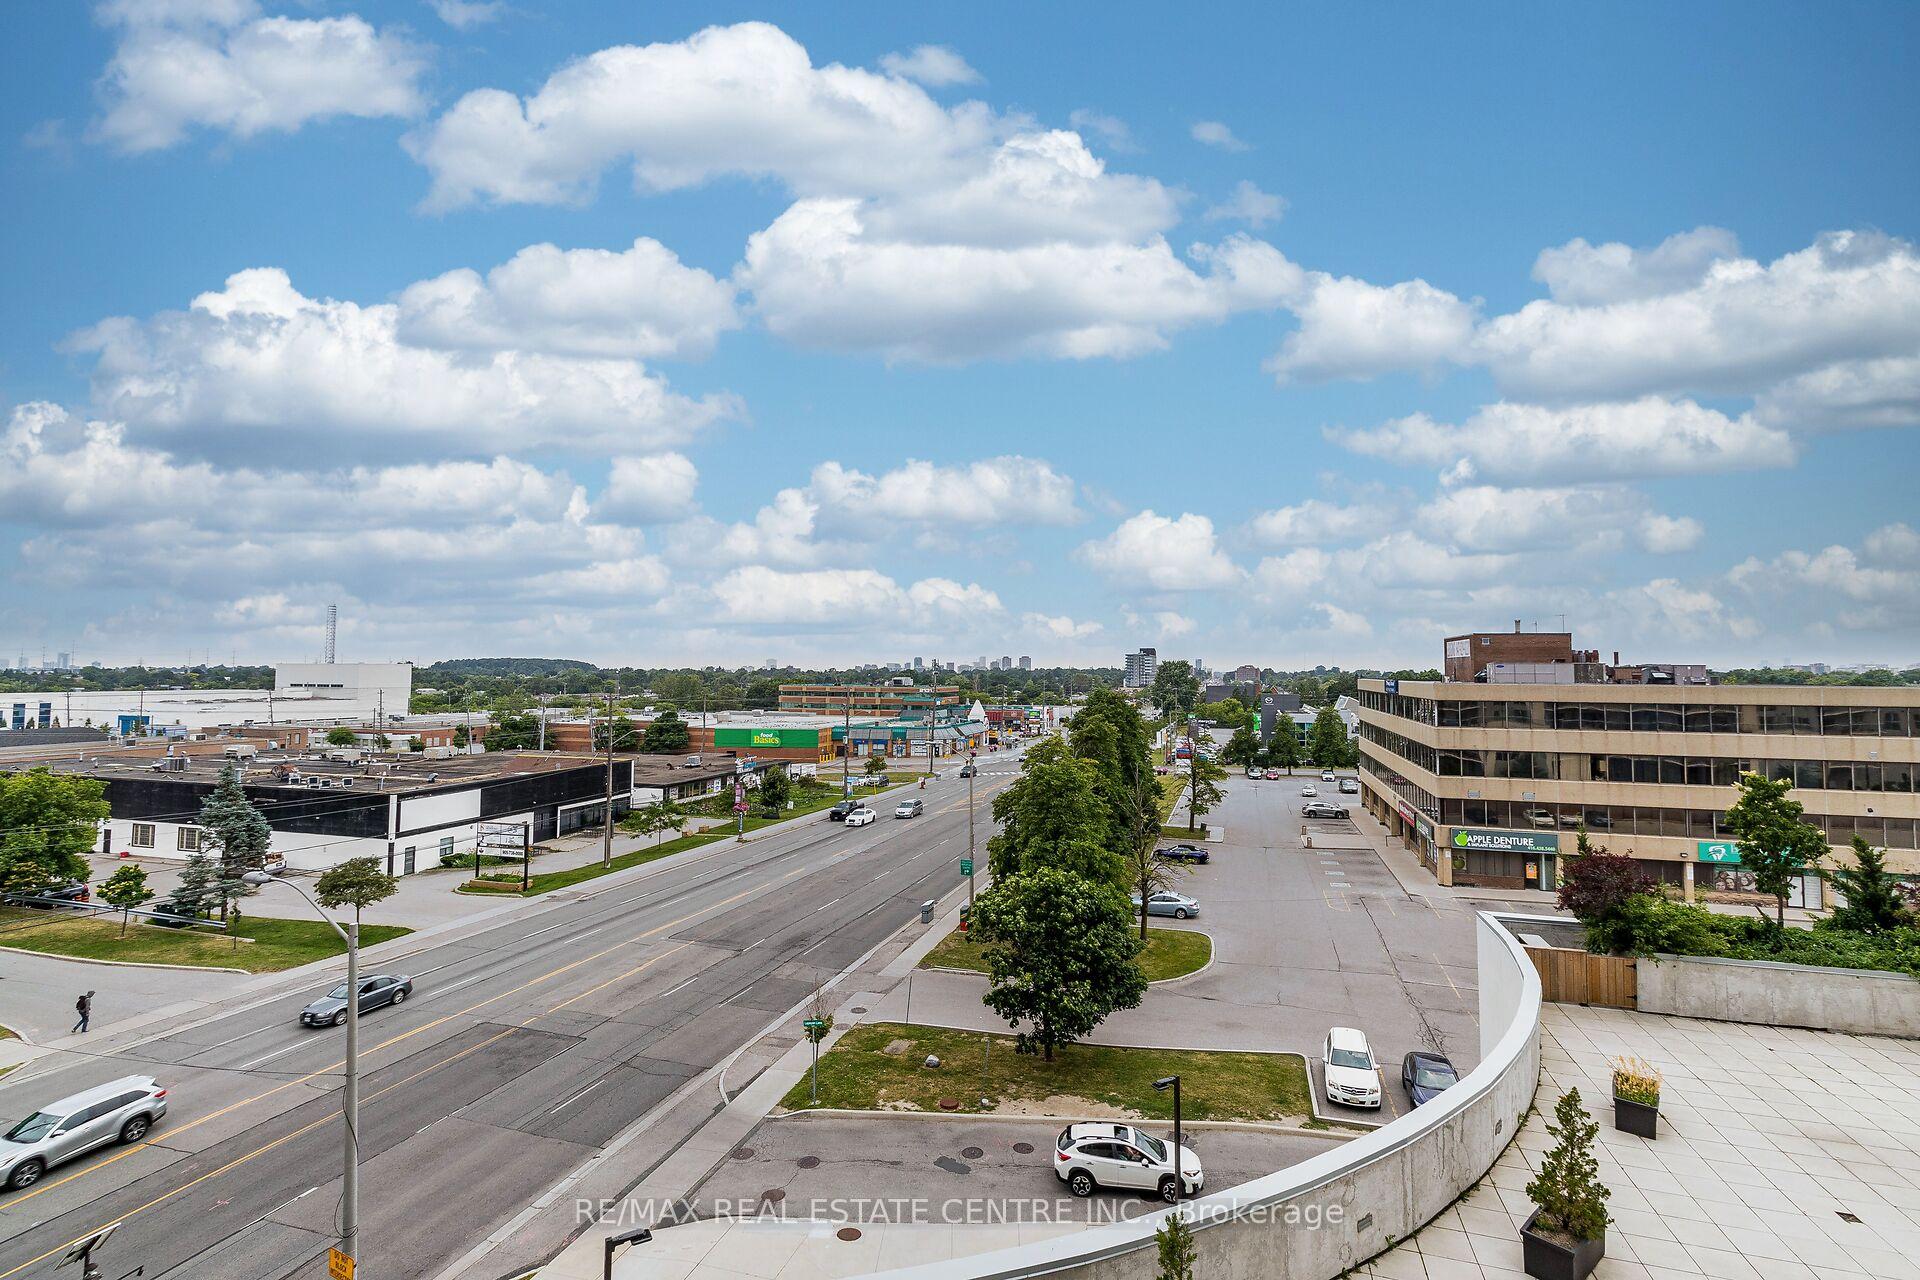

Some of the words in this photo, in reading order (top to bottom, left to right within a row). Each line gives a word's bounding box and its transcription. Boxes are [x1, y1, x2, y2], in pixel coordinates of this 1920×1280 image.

[753, 736, 779, 744] Basics
[1467, 835, 1491, 844] APPLE
[1494, 836, 1533, 846] DENTURE
